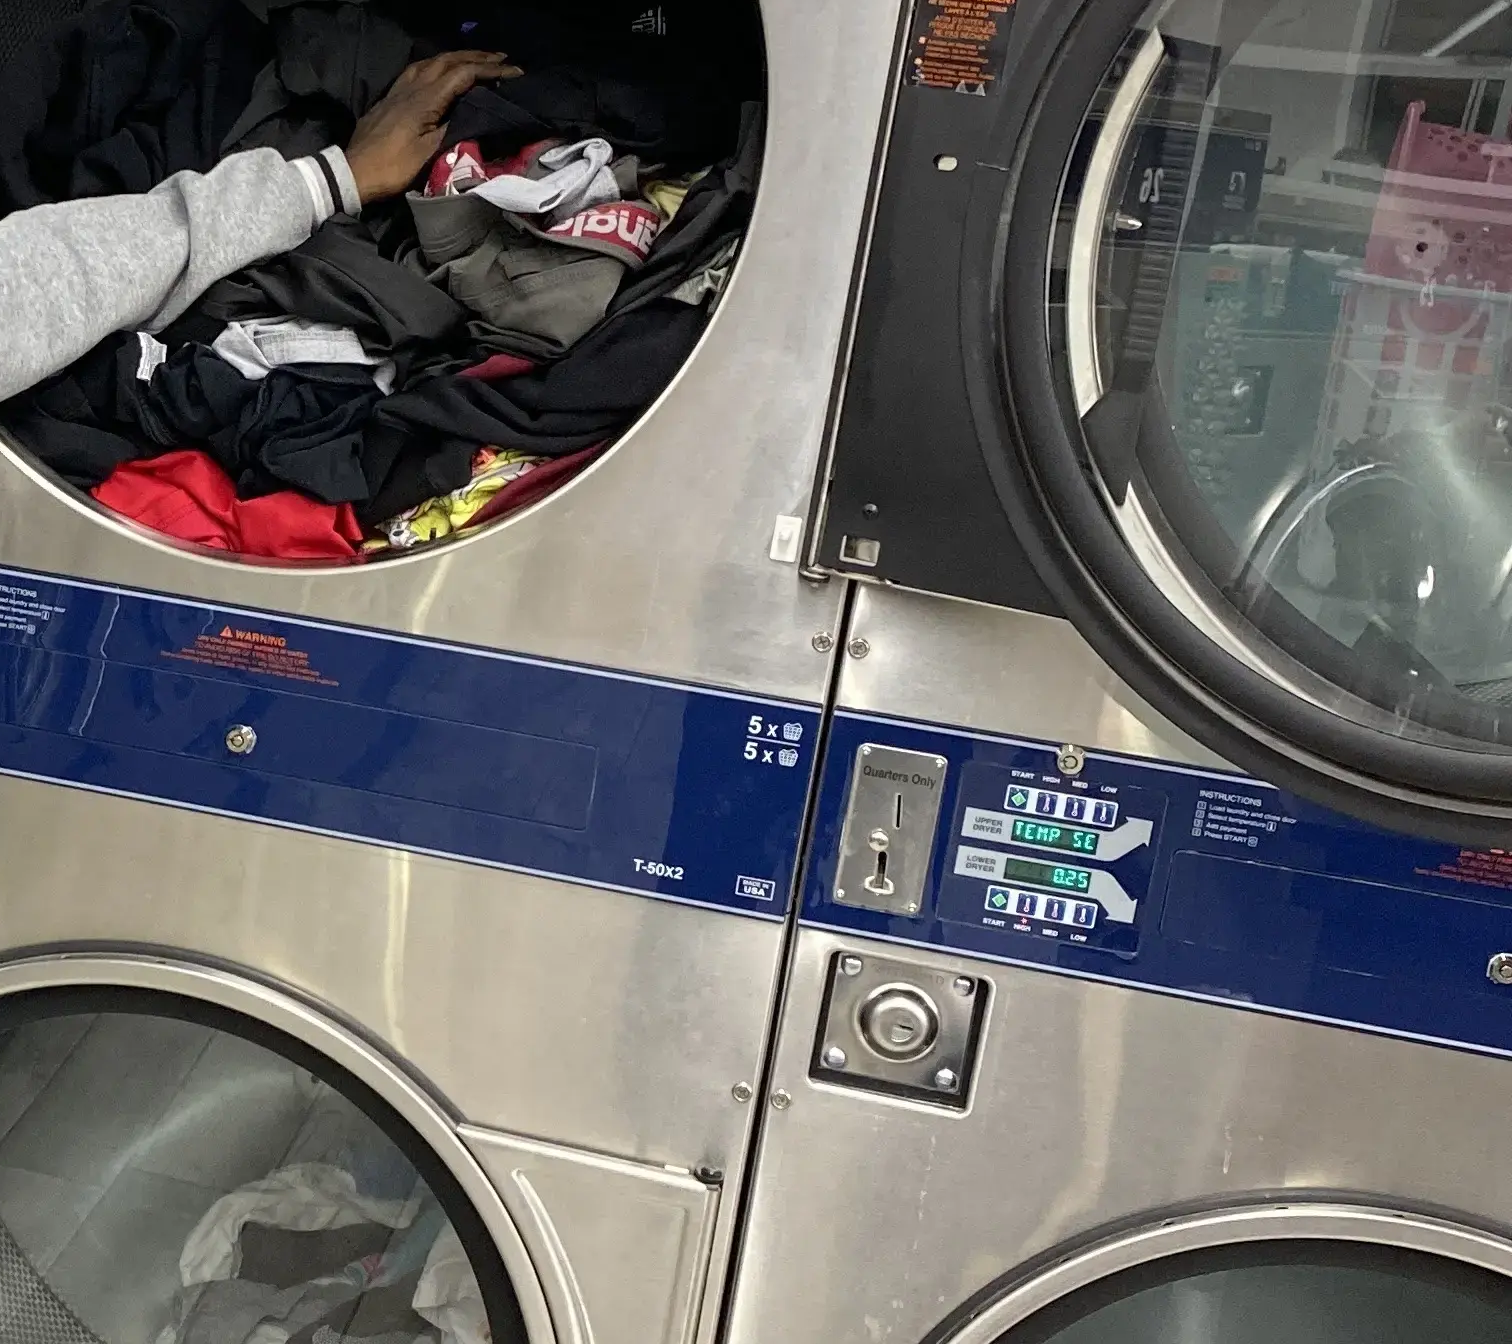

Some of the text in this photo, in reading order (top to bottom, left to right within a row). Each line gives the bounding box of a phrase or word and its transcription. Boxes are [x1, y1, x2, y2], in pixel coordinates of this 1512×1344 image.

[235, 630, 286, 647] WARNING
[748, 715, 779, 738] 5 x
[743, 741, 774, 764] 5 x
[863, 765, 936, 790] Quarters Only
[1011, 770, 1035, 780] START
[1072, 780, 1088, 789] MED
[1100, 785, 1118, 794] LOW
[1199, 790, 1262, 806] INSTRUCTIONS
[972, 824, 1002, 835] DRYER
[975, 816, 1003, 827] UPPER
[1015, 822, 1096, 850] TEMP SE
[633, 857, 684, 881] T-50X2
[965, 862, 995, 873] DRYER
[966, 855, 996, 865] LOWER
[744, 886, 765, 896] USA
[982, 917, 1006, 927] START
[1070, 933, 1087, 942] LOW
